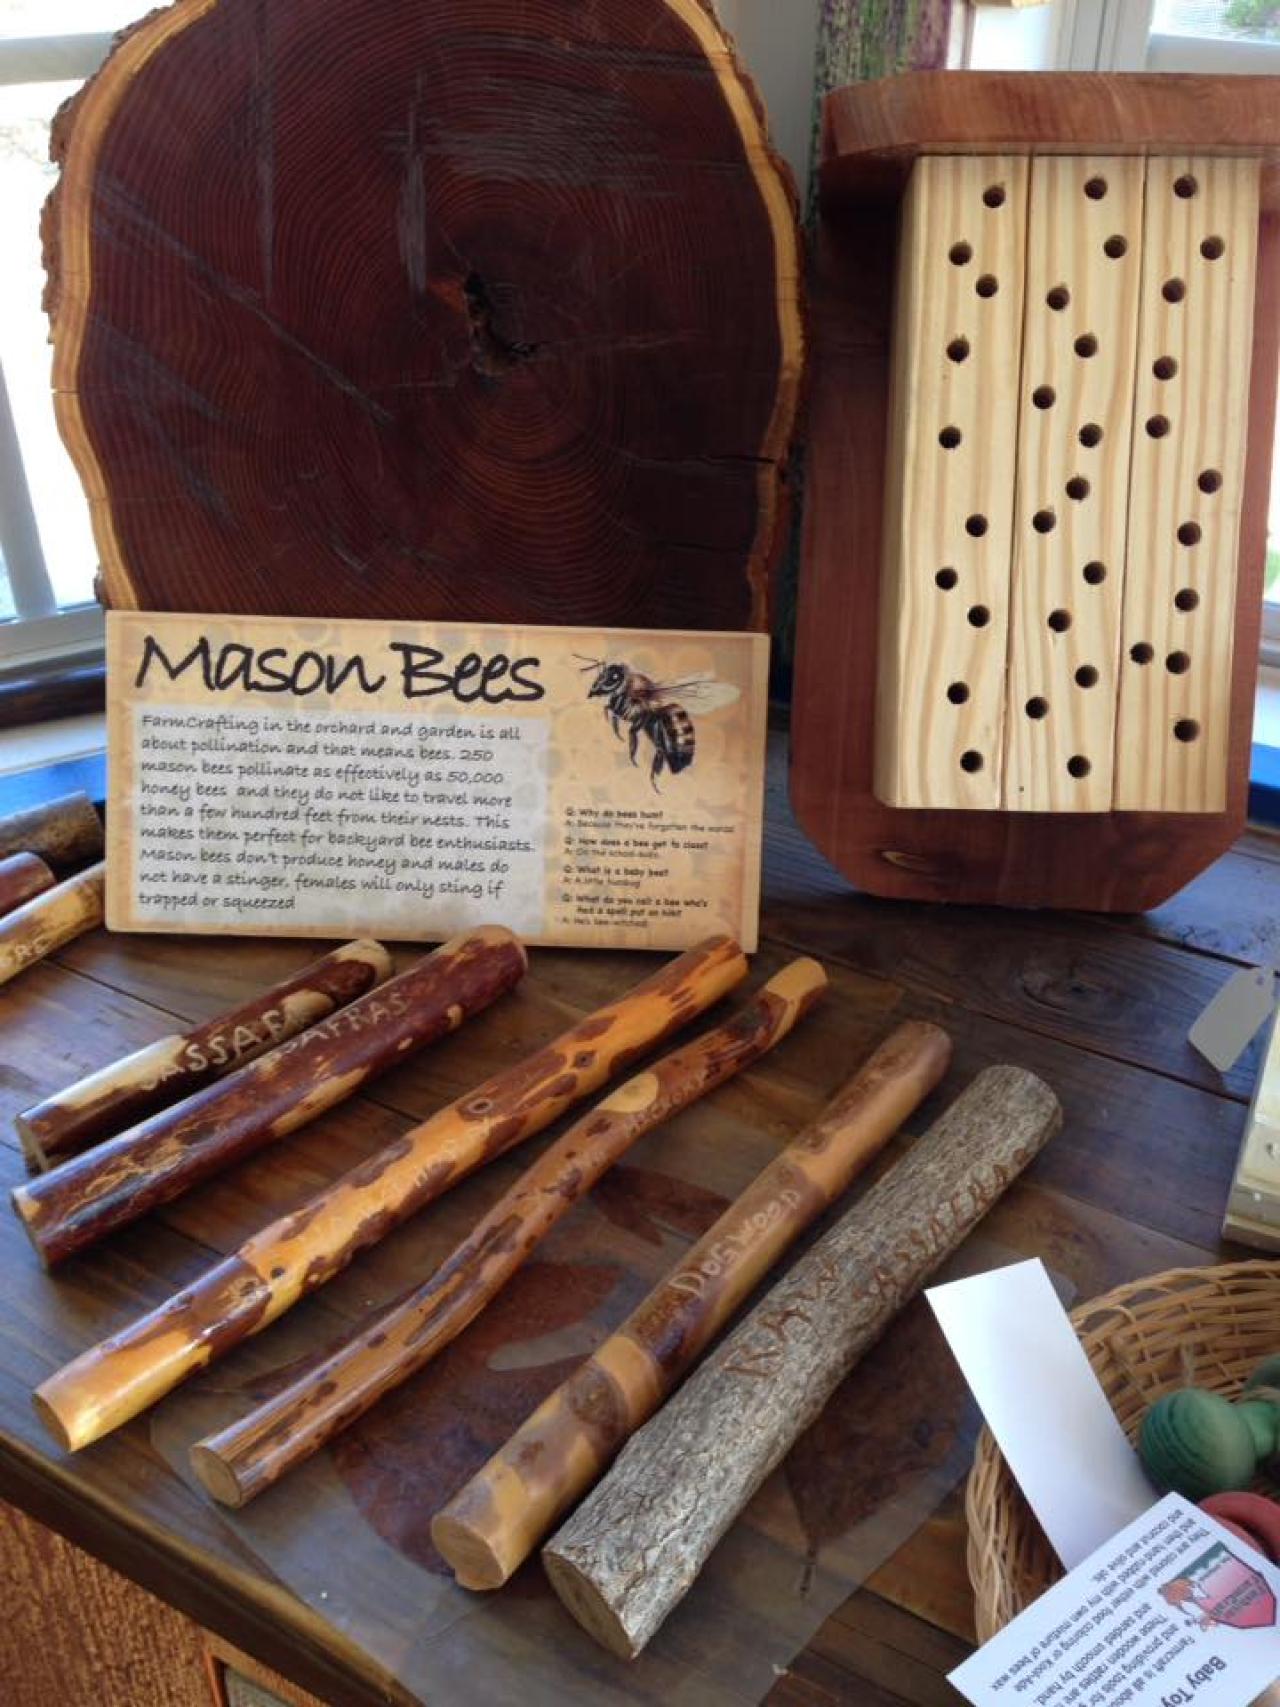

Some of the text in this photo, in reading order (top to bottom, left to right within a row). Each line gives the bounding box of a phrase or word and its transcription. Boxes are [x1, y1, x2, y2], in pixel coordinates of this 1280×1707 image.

[135, 635, 546, 703] Mason Bees
[143, 715, 521, 741] FarmCrafting in the orchard and garden is all
[142, 738, 186, 750] about
[192, 737, 281, 756] pollination
[286, 741, 318, 754] and
[323, 743, 357, 756] that
[361, 746, 415, 759] means
[459, 750, 493, 761] 250
[141, 759, 503, 787] mason bees pollinate as effectively as 50,000
[141, 781, 512, 808] honey bees and they do not like to travel more
[140, 804, 180, 816] than
[184, 806, 193, 817] a
[199, 804, 226, 822] few
[231, 806, 299, 819] hundred
[303, 807, 332, 825] feet
[337, 808, 377, 827] from
[381, 811, 418, 824] their
[474, 814, 510, 829] This
[579, 808, 599, 818] Why
[141, 827, 535, 852] makes them perfect for backyard bee enthusiasts.
[141, 848, 509, 875] Mason bees don't produce honey and males do
[624, 868, 645, 877] baby
[140, 870, 167, 882] not
[172, 870, 208, 884] have
[213, 874, 221, 884] a
[294, 873, 362, 891] females
[361, 875, 391, 890] will
[396, 880, 435, 899] only
[438, 879, 483, 899] sting
[488, 879, 504, 899] if
[139, 893, 295, 913] trapped or squeezed
[1167, 1508, 1183, 1523] and
[1179, 1517, 1194, 1532] and
[1163, 1529, 1182, 1546] then
[1177, 1541, 1189, 1553] are
[1126, 1542, 1142, 1557] and
[1144, 1542, 1165, 1562] hand
[1118, 1557, 1146, 1583] rubbed
[1149, 1550, 1177, 1577] colored
[1101, 1579, 1120, 1596] with
[1132, 1572, 1151, 1591] with
[1087, 1593, 1102, 1607] my
[1111, 1587, 1134, 1609] either
[1070, 1605, 1088, 1622] own
[1092, 1606, 1112, 1625] food
[1134, 1602, 1151, 1619] and
[1039, 1619, 1072, 1649] mixture
[1059, 1619, 1095, 1652] coloring
[1103, 1615, 1137, 1646] sanded
[1030, 1646, 1041, 1658] of
[1050, 1648, 1063, 1660] or
[1062, 1611, 1167, 1704] These wooden rattles are
[1072, 1642, 1106, 1674] smooth
[1008, 1654, 1032, 1677] bees
[1088, 1622, 1179, 1707] and providing tools for
[1058, 1668, 1074, 1684] by
[1131, 1677, 1147, 1692] all
[1161, 1656, 1227, 1707] Baby Toy
